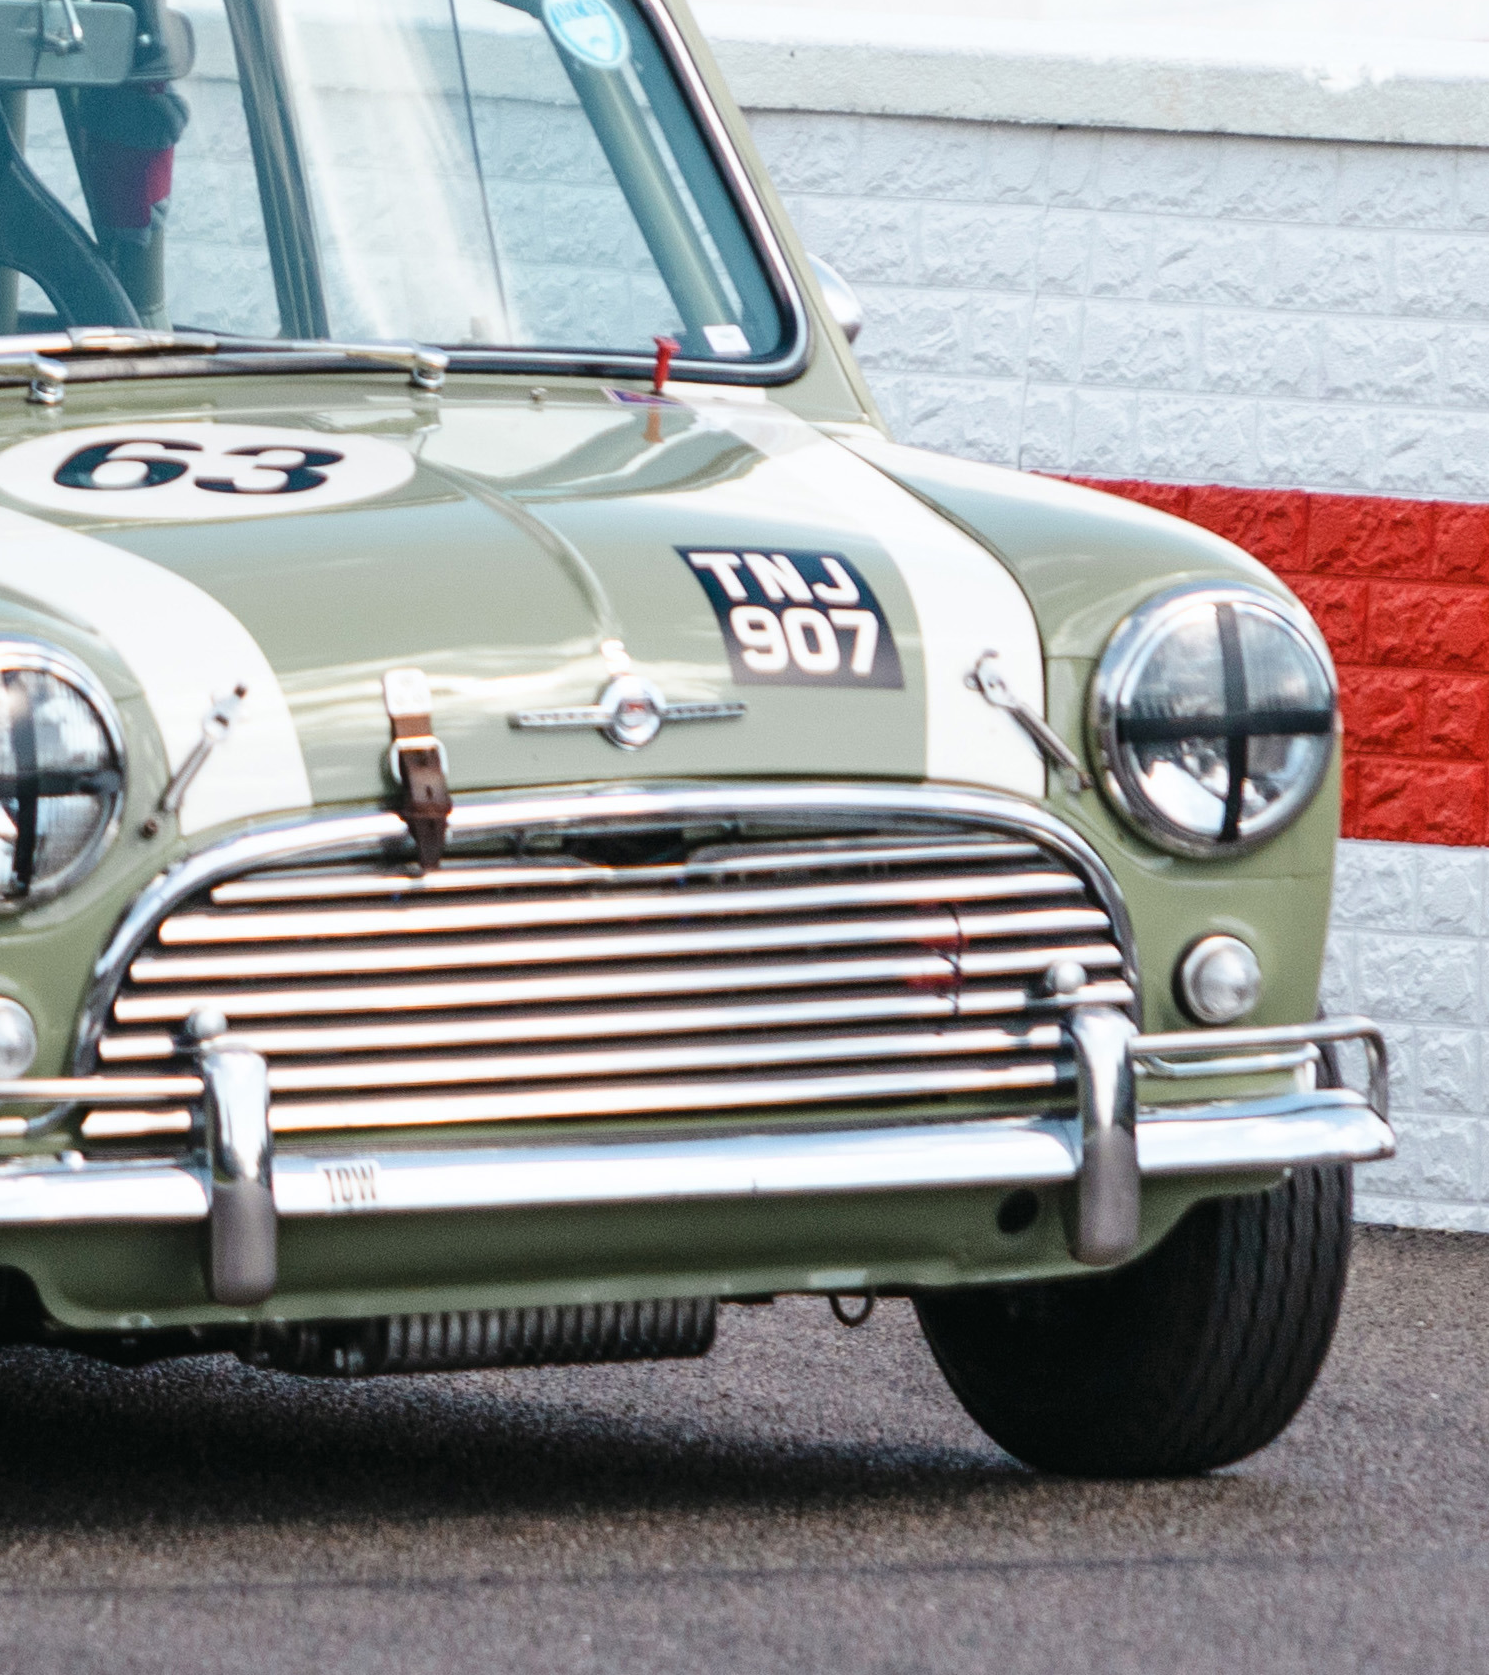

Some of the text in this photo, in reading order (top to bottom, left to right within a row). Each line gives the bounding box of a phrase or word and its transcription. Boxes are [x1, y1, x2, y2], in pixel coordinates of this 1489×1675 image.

[52, 437, 345, 495] 63
[686, 551, 861, 606] TNJ
[728, 604, 879, 676] 907
[322, 1165, 377, 1204] TOW
